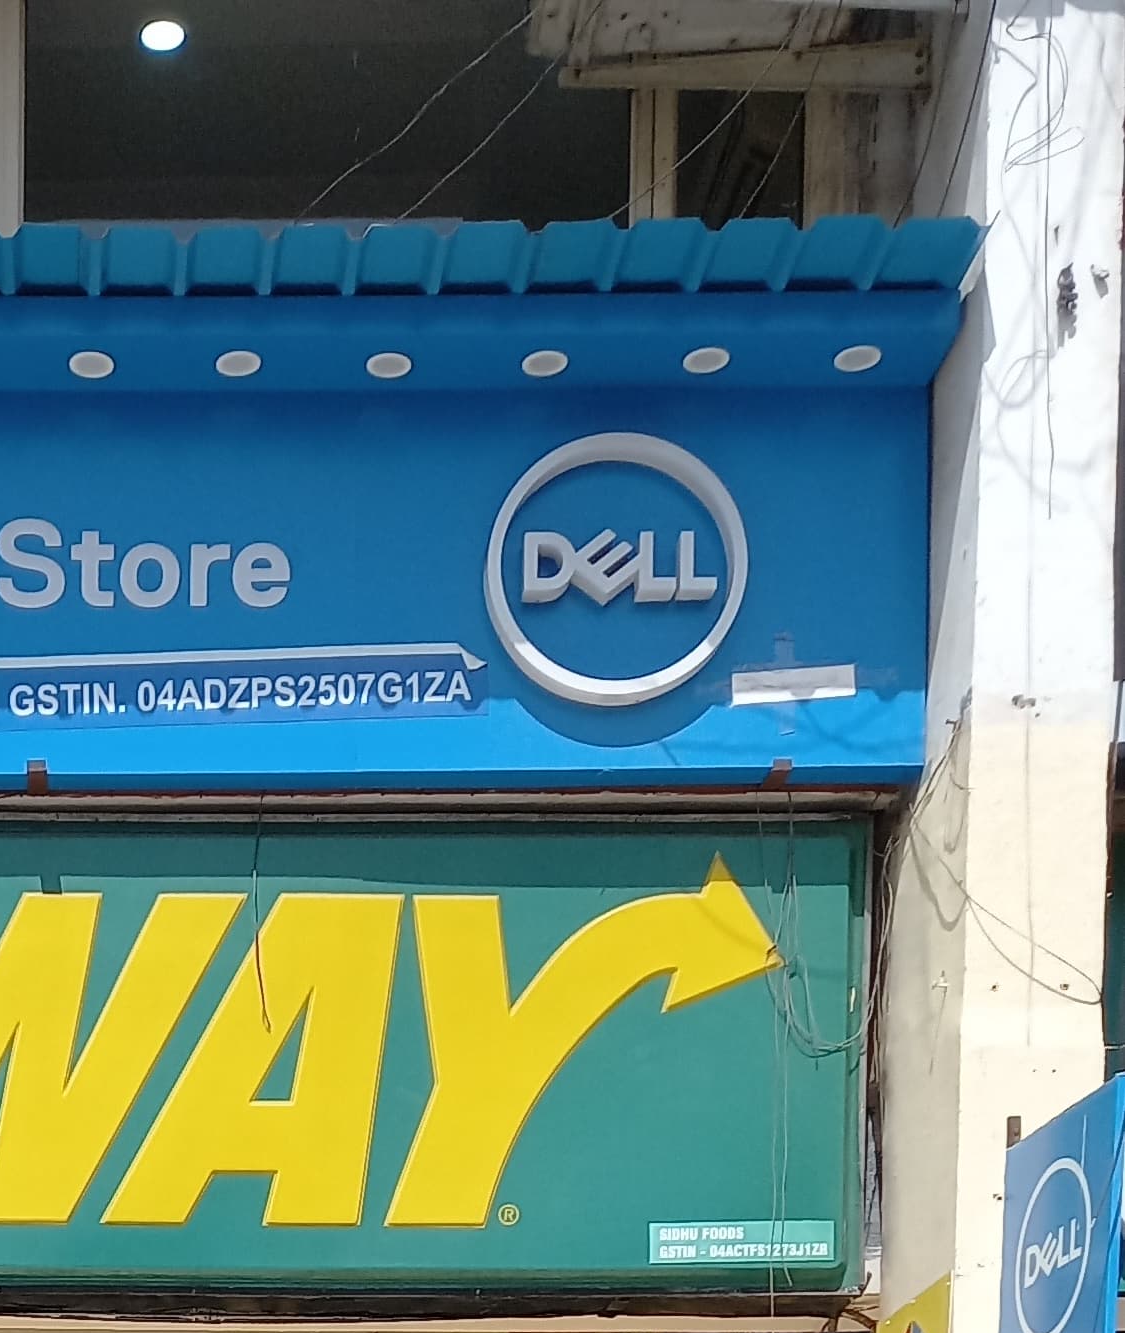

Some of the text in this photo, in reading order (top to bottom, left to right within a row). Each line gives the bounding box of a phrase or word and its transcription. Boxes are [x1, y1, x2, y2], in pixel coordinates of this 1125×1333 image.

[520, 526, 720, 607] DELL
[8, 669, 473, 718] GSTIN. 04ADZPS2507G1ZA
[659, 1226, 745, 1241] SIDHU FOODS
[659, 1244, 696, 1259] GSTIN
[1023, 1217, 1083, 1291] DELL
